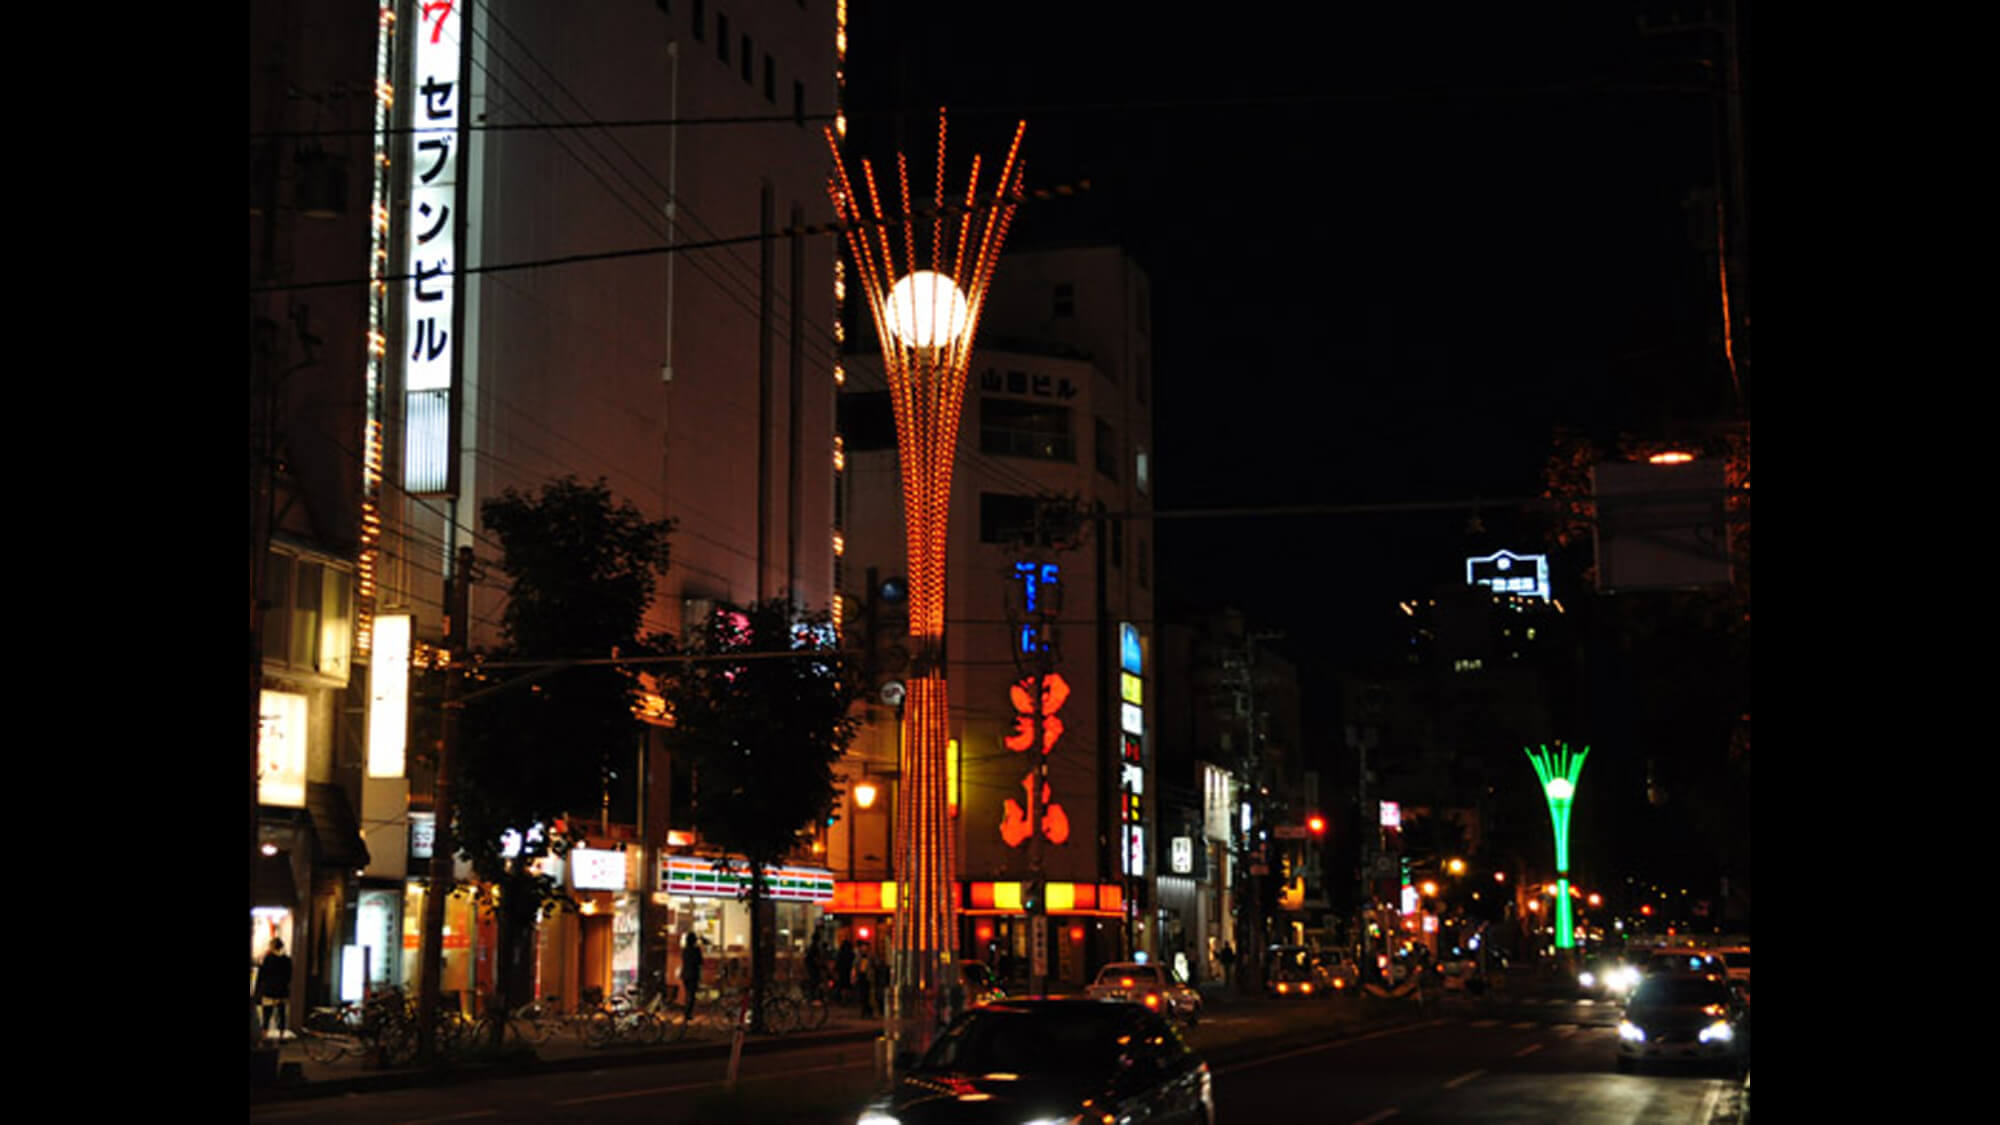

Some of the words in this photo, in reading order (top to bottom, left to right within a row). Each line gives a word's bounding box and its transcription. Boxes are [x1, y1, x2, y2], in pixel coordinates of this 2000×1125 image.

[422, 0, 451, 43] 7
[412, 76, 453, 362] セブンビル
